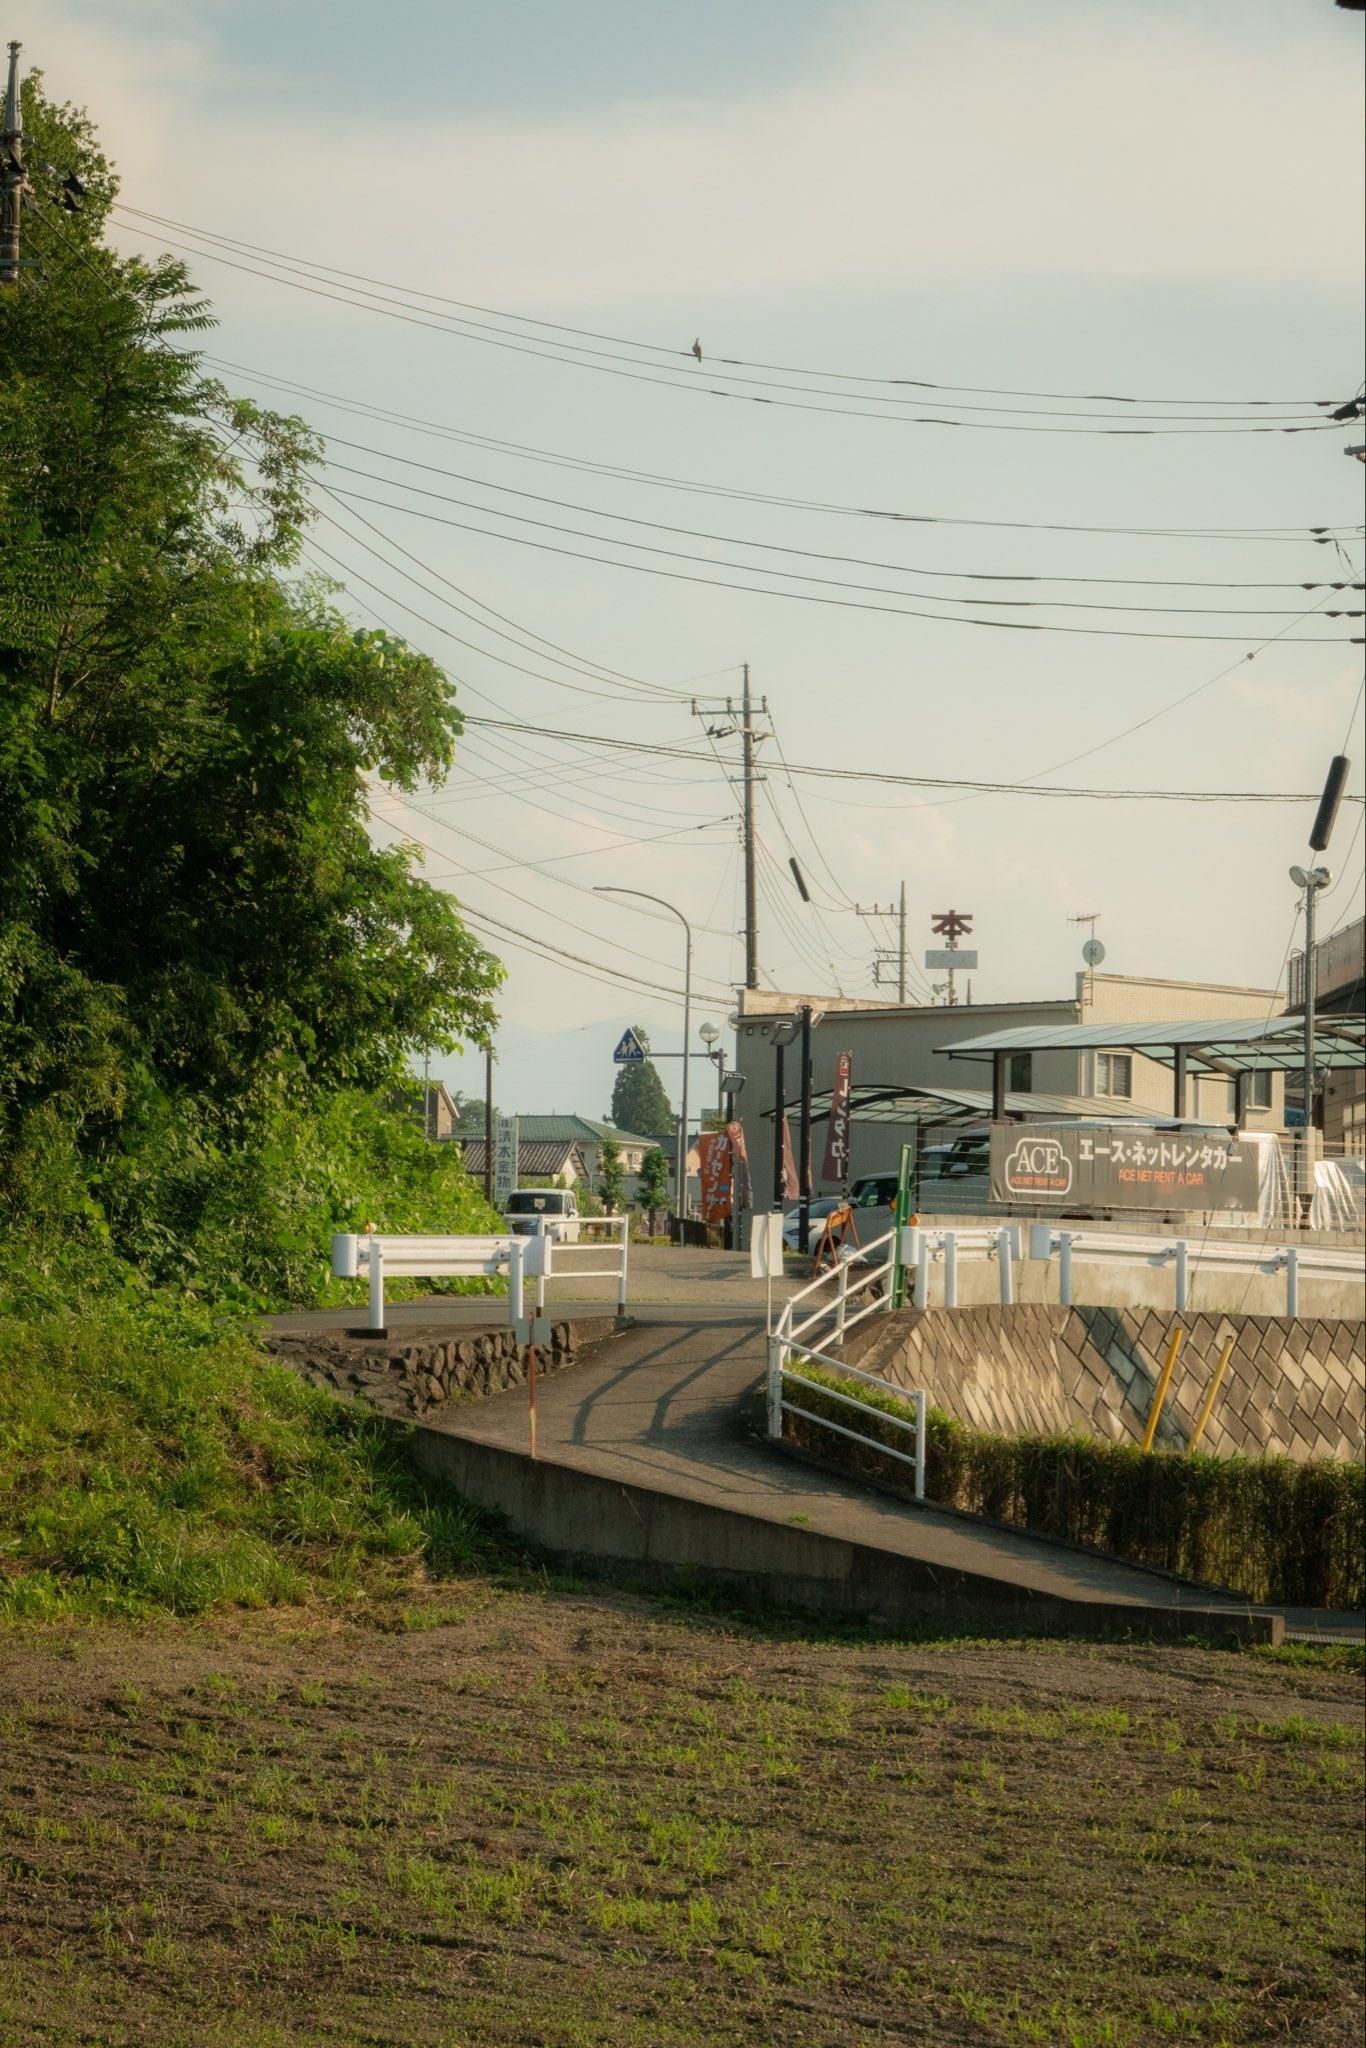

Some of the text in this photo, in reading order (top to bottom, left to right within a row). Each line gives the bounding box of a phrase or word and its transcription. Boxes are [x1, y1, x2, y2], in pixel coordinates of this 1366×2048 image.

[931, 909, 973, 940] 本
[1016, 1146, 1059, 1174] ACE
[1079, 1139, 1242, 1170] エース・ネットレンタカー
[1118, 1169, 1204, 1185] ACE NET RENT A CAR
